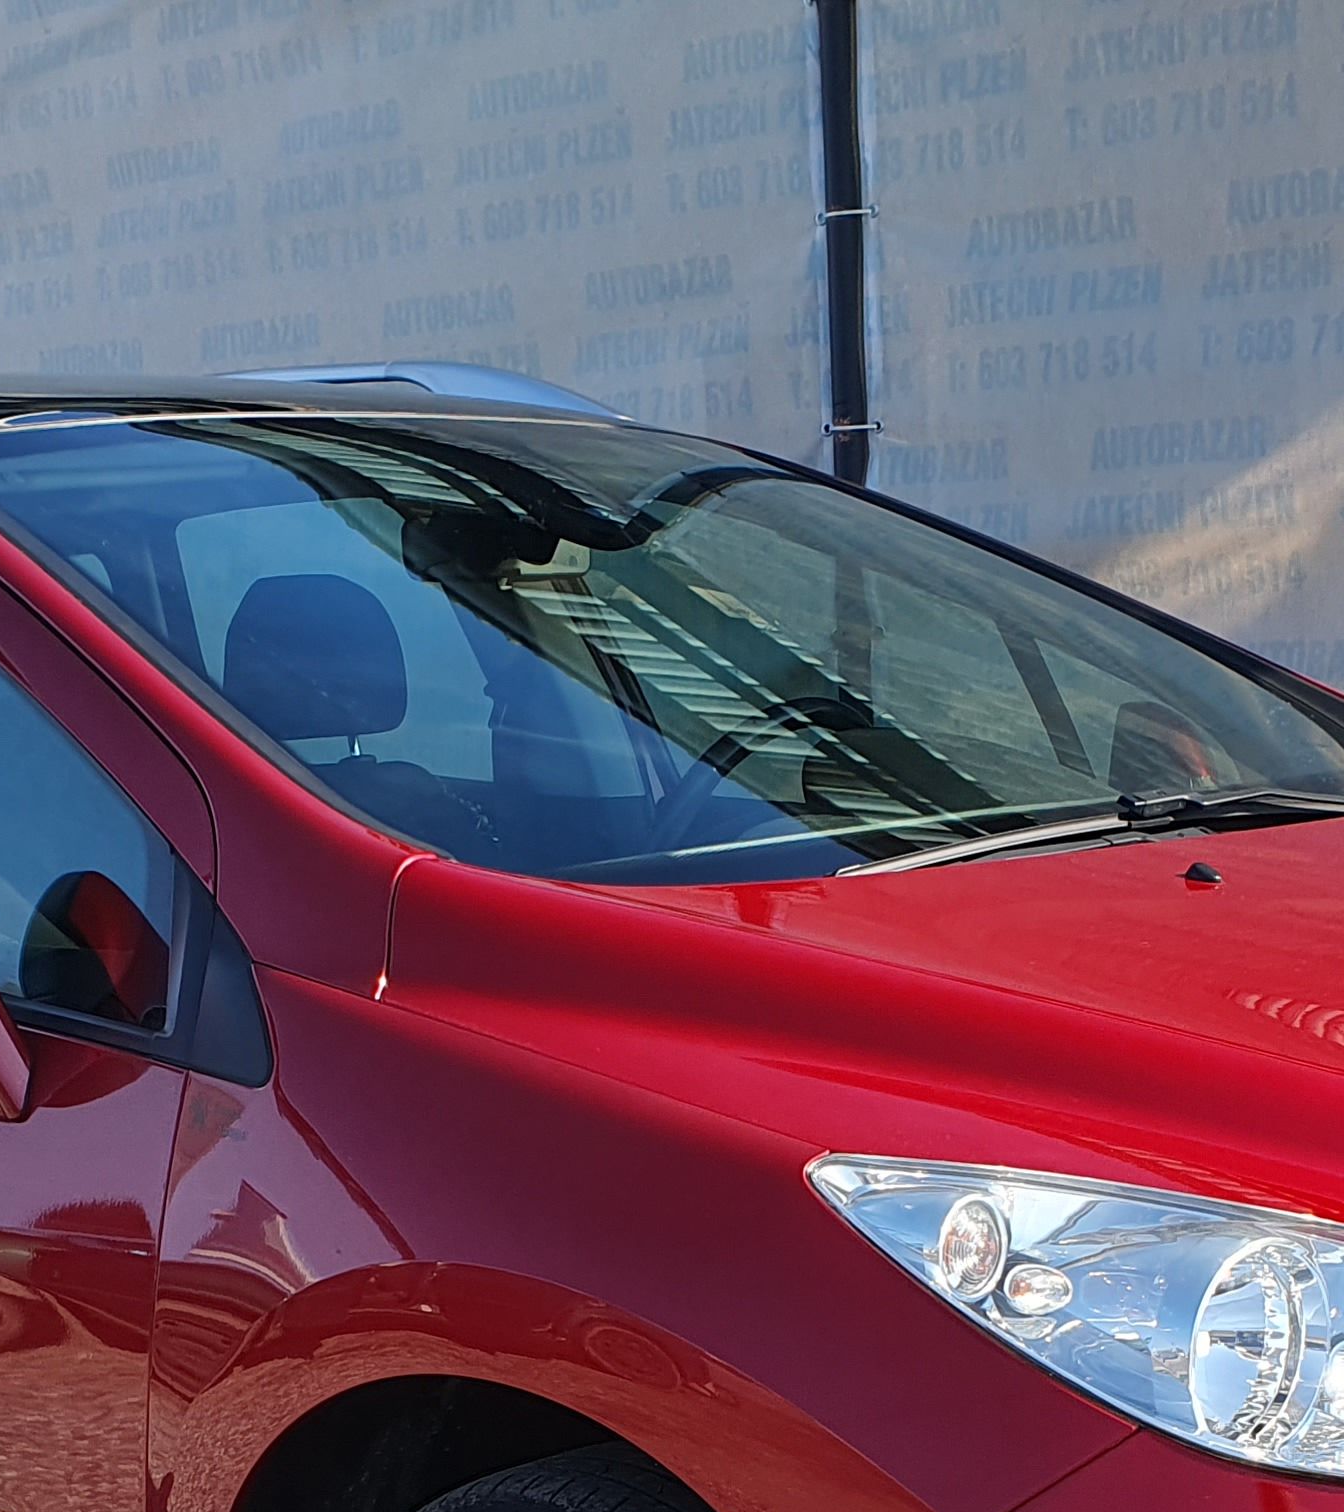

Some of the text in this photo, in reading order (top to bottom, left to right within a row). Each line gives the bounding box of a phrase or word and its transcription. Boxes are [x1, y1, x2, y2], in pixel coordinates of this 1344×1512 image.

[1201, 224, 1333, 299] JATEČNÍ
[1199, 322, 1224, 369] T:
[1236, 315, 1296, 366] 603
